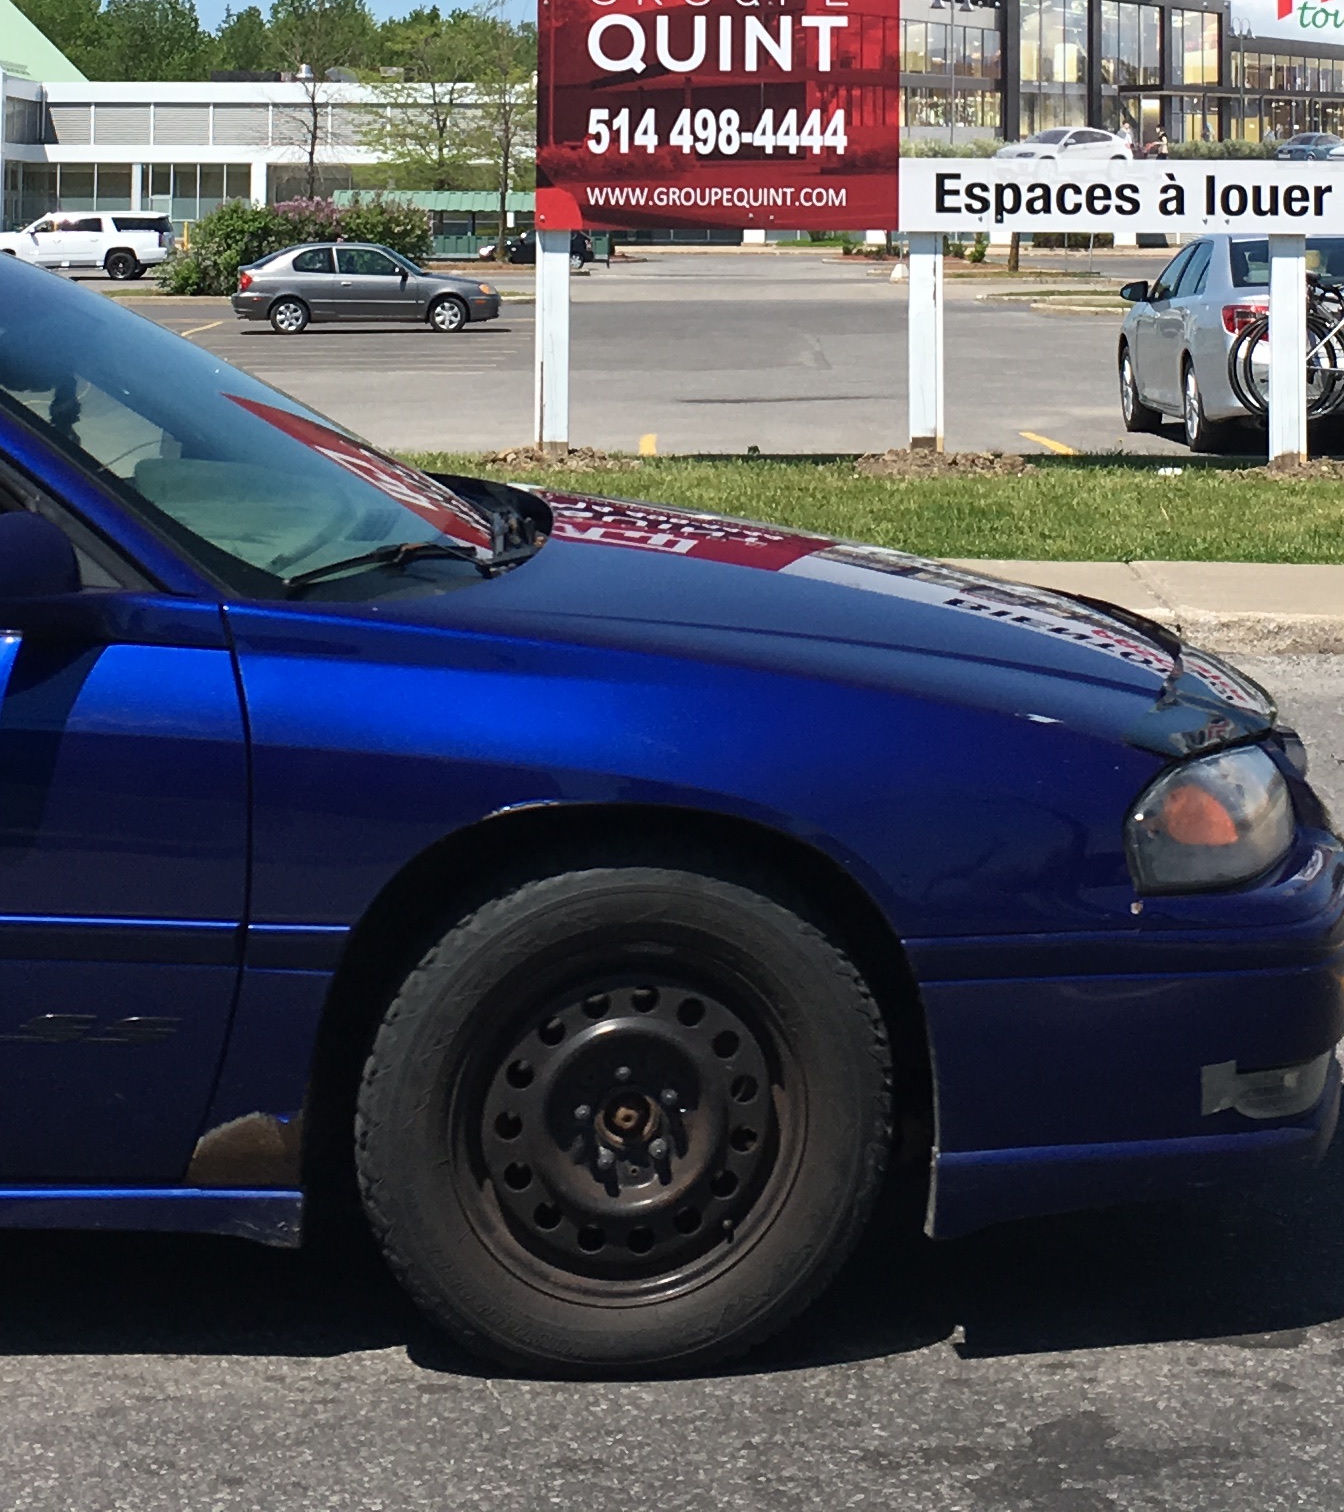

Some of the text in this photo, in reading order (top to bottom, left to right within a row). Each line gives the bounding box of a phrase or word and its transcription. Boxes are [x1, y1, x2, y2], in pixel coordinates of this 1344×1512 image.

[587, 13, 849, 74] QUINT
[587, 107, 848, 156] 514 498-4444
[586, 186, 848, 208] WWW.GROUPEQUINT.COM
[934, 170, 1141, 222] Espaces
[1158, 172, 1186, 218] à
[1205, 174, 1334, 219] louer
